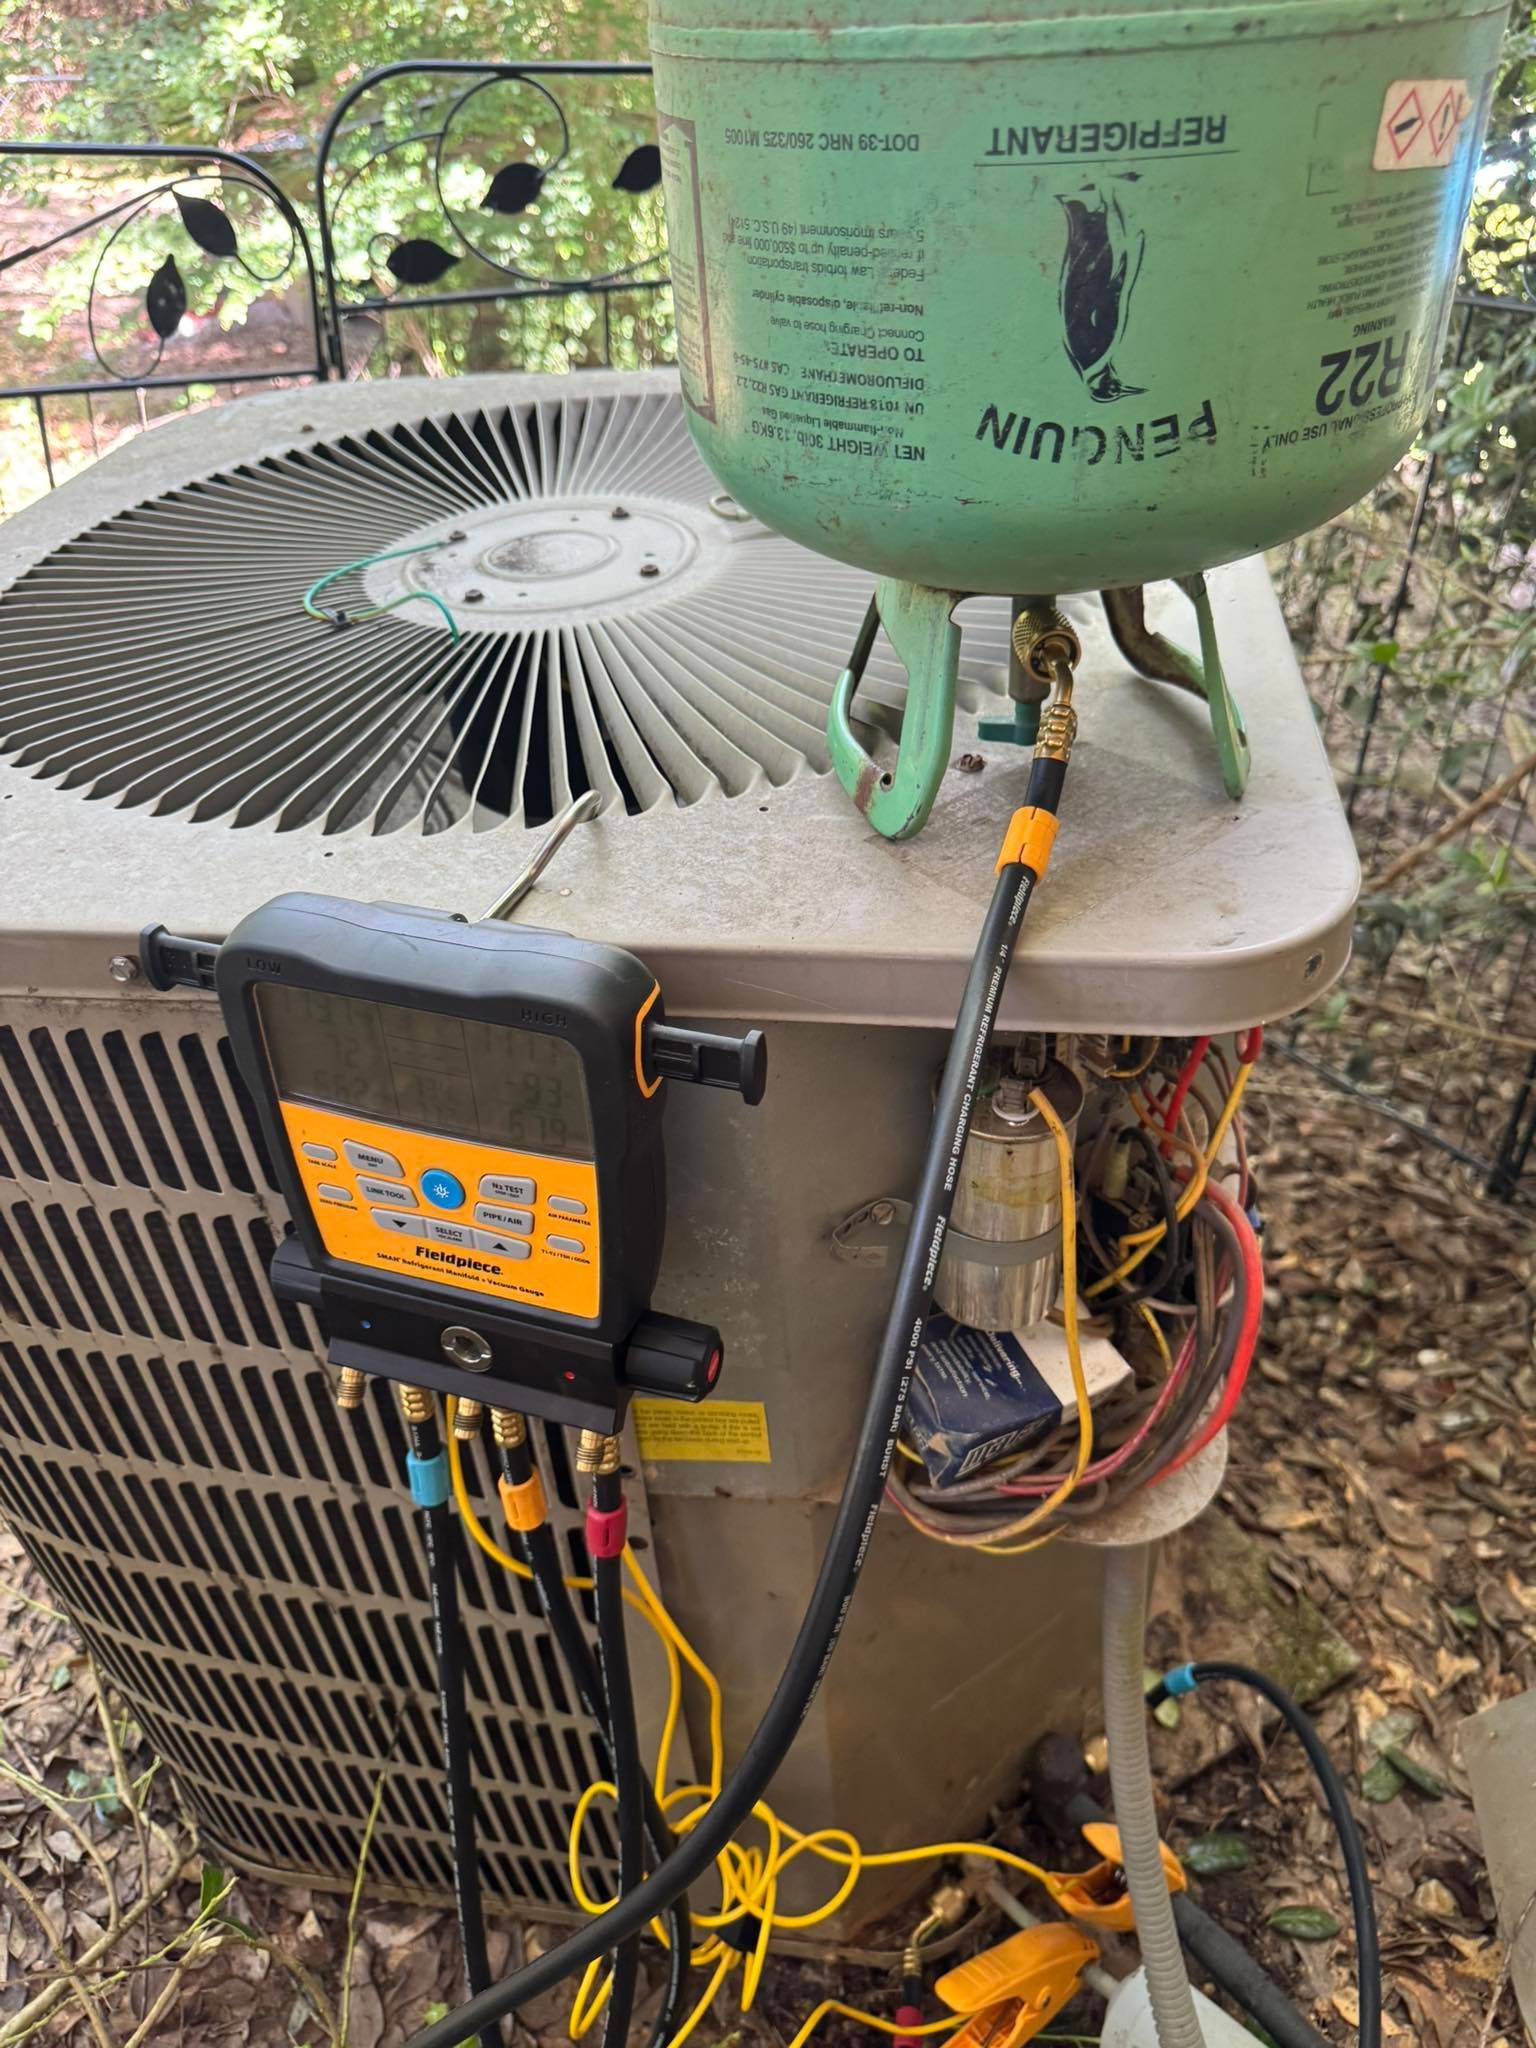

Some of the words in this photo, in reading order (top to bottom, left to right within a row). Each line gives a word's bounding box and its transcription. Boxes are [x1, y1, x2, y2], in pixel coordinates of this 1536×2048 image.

[725, 128, 760, 147] M1005
[763, 130, 815, 149] 260/325
[819, 133, 853, 151] NRC
[858, 133, 919, 152] DOT-39
[798, 243, 808, 255] to
[811, 242, 824, 256] up
[811, 263, 848, 278] forbids
[851, 266, 874, 280] Law
[752, 289, 785, 304] cylinder
[786, 294, 841, 310] disposable
[770, 316, 791, 330] valve
[793, 320, 802, 332] to
[804, 321, 826, 336] hose
[829, 321, 875, 339] Charging
[1352, 314, 1397, 338] WARNING
[878, 328, 924, 342] Connect
[904, 347, 925, 362] TO
[771, 361, 790, 376] CAS
[1315, 330, 1410, 417] R22
[769, 383, 788, 398] GAS
[762, 407, 778, 420] Gas
[905, 402, 924, 415] UN
[824, 419, 903, 438] No-flammable
[1302, 423, 1328, 441] USE
[827, 437, 888, 458] WEIGHT
[1261, 430, 1299, 454] ONLY
[895, 445, 925, 461] NET
[1009, 875, 1030, 925] Fieldpiece
[985, 966, 1002, 1014] PREMIUM
[966, 1014, 990, 1092] REFRIGERANT
[952, 1093, 972, 1155] CHARGING
[357, 1153, 383, 1164] MENU
[944, 1156, 958, 1192] HOSE
[385, 1188, 406, 1201] TOOL
[504, 1185, 524, 1195] TEST
[507, 1217, 523, 1226] AIR
[435, 1226, 463, 1238] SELECT
[923, 1214, 946, 1286] Fieldpiece
[415, 1245, 500, 1276] Fieldpiece
[486, 1278, 518, 1291] Vacuum
[518, 1285, 544, 1297] Gauge
[910, 1317, 922, 1347] 4000
[905, 1350, 916, 1370] PSI
[880, 1438, 895, 1478] BURST
